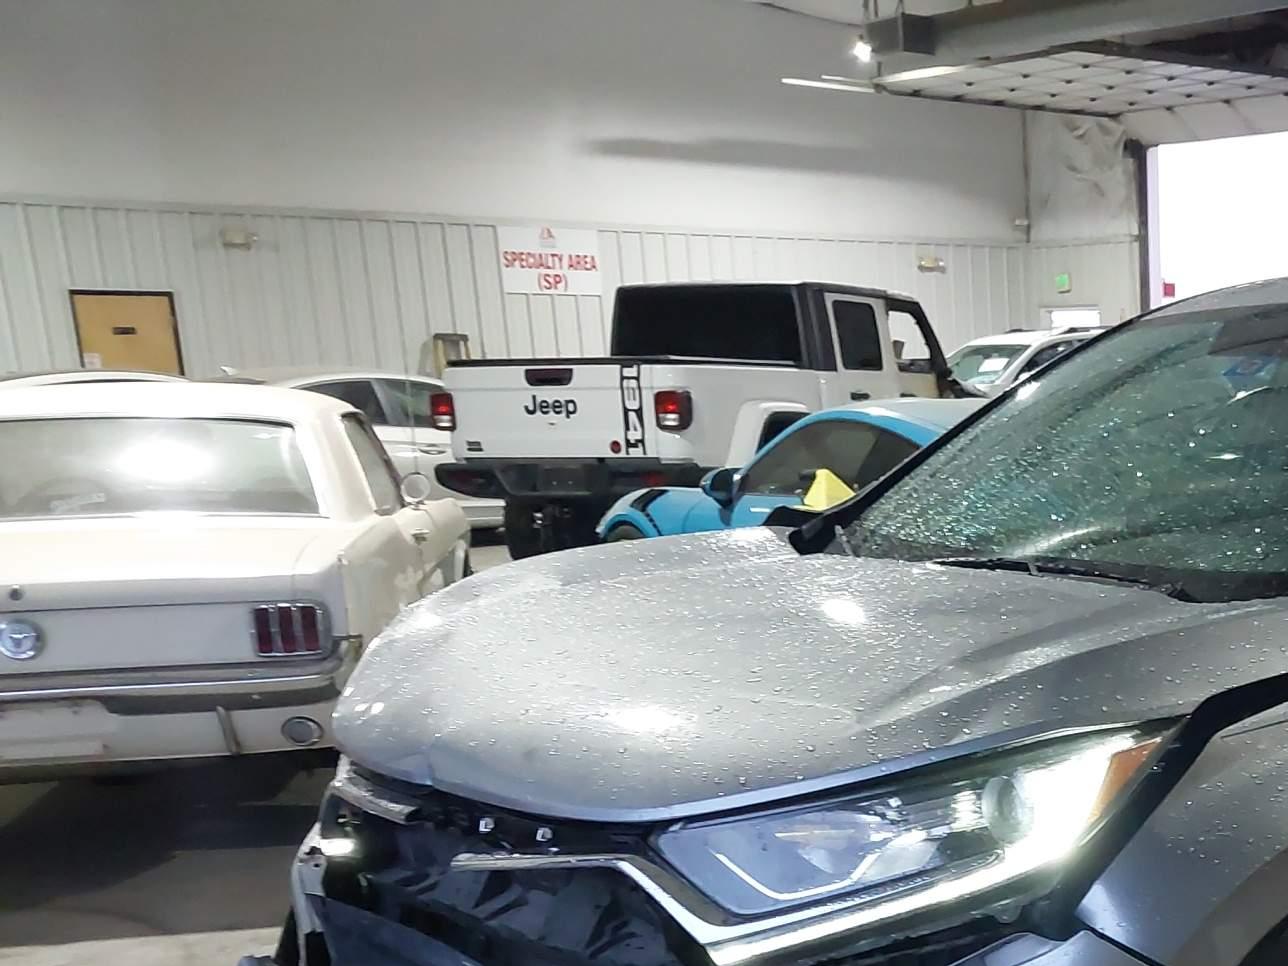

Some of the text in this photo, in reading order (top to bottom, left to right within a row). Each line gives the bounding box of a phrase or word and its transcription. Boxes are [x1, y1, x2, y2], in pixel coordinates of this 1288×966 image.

[502, 250, 598, 271] SPECIALTY AREA
[537, 272, 569, 292] (SP)
[523, 394, 578, 419] Jeep
